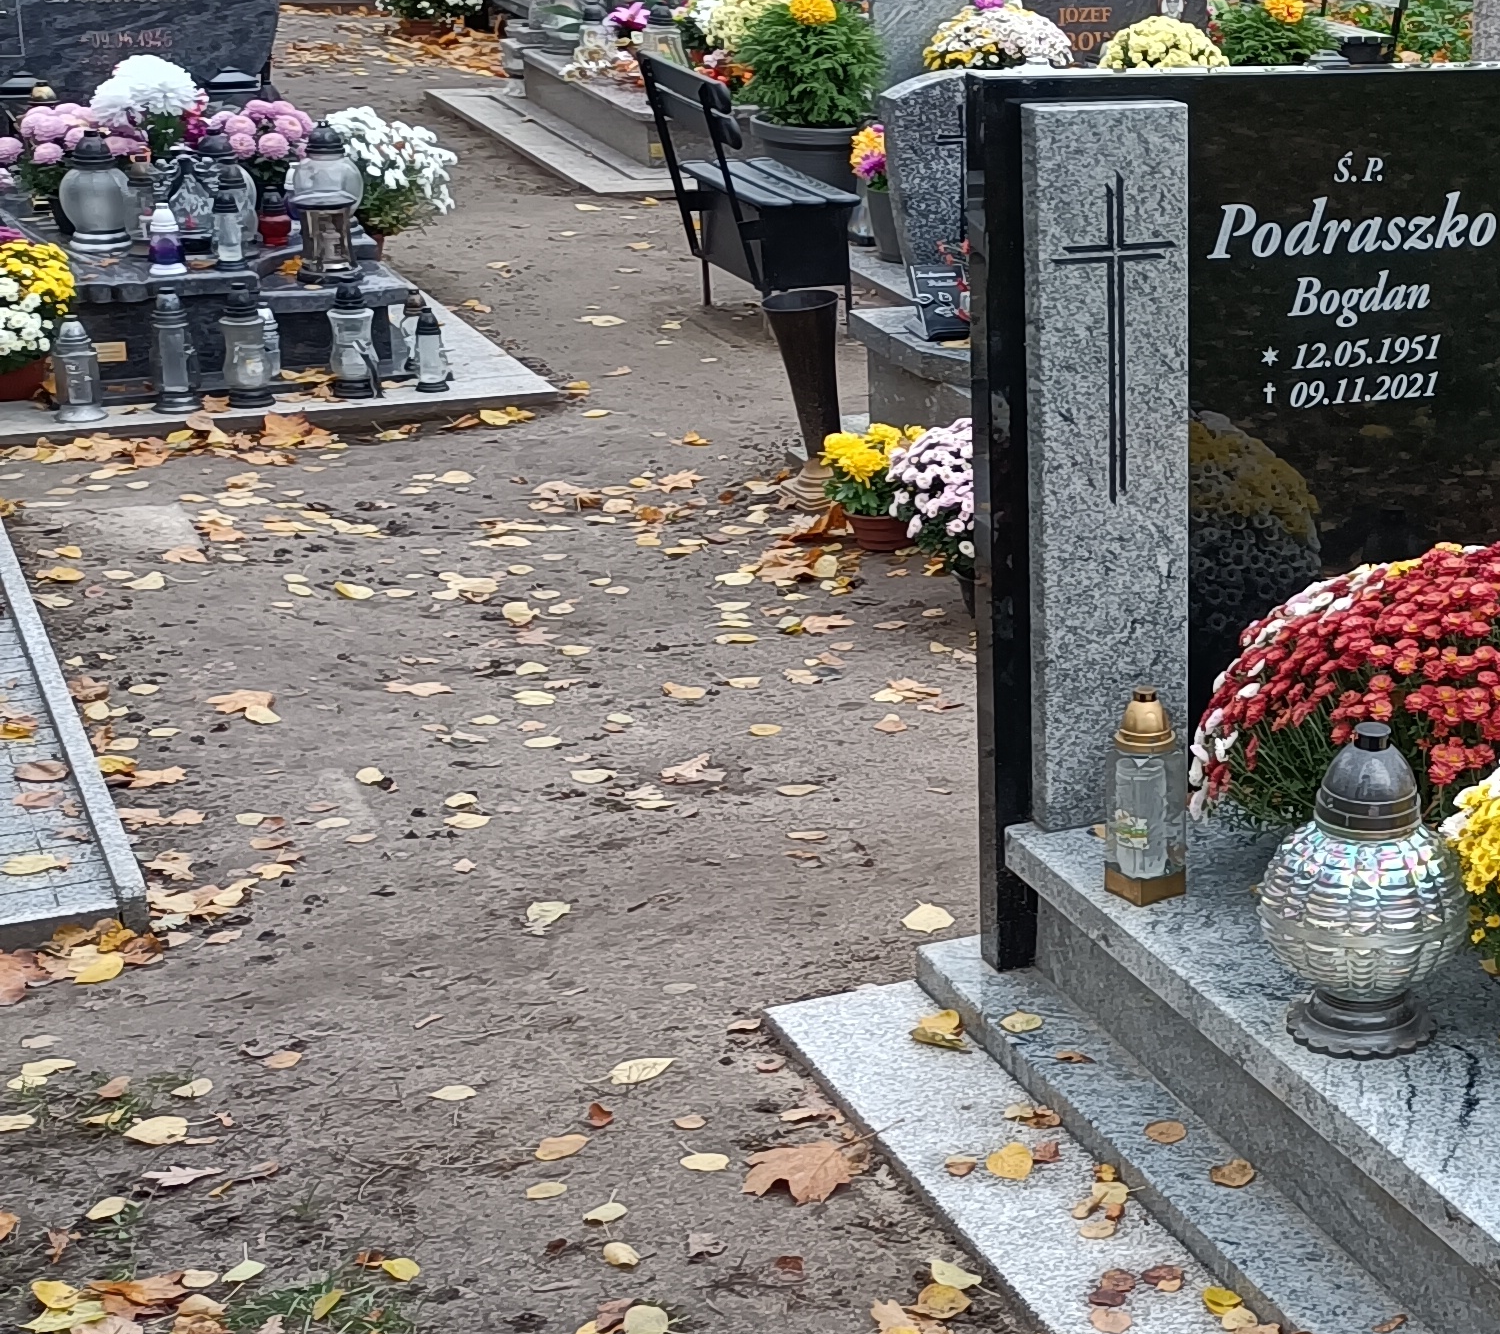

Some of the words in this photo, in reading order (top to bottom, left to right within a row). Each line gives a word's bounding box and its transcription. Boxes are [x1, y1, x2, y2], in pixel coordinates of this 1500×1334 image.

[1206, 190, 1497, 259] Podraszko
[1287, 269, 1430, 328] Bogdan
[1291, 333, 1441, 370] 12.05.1951
[1289, 371, 1439, 408] 09.11.2021
